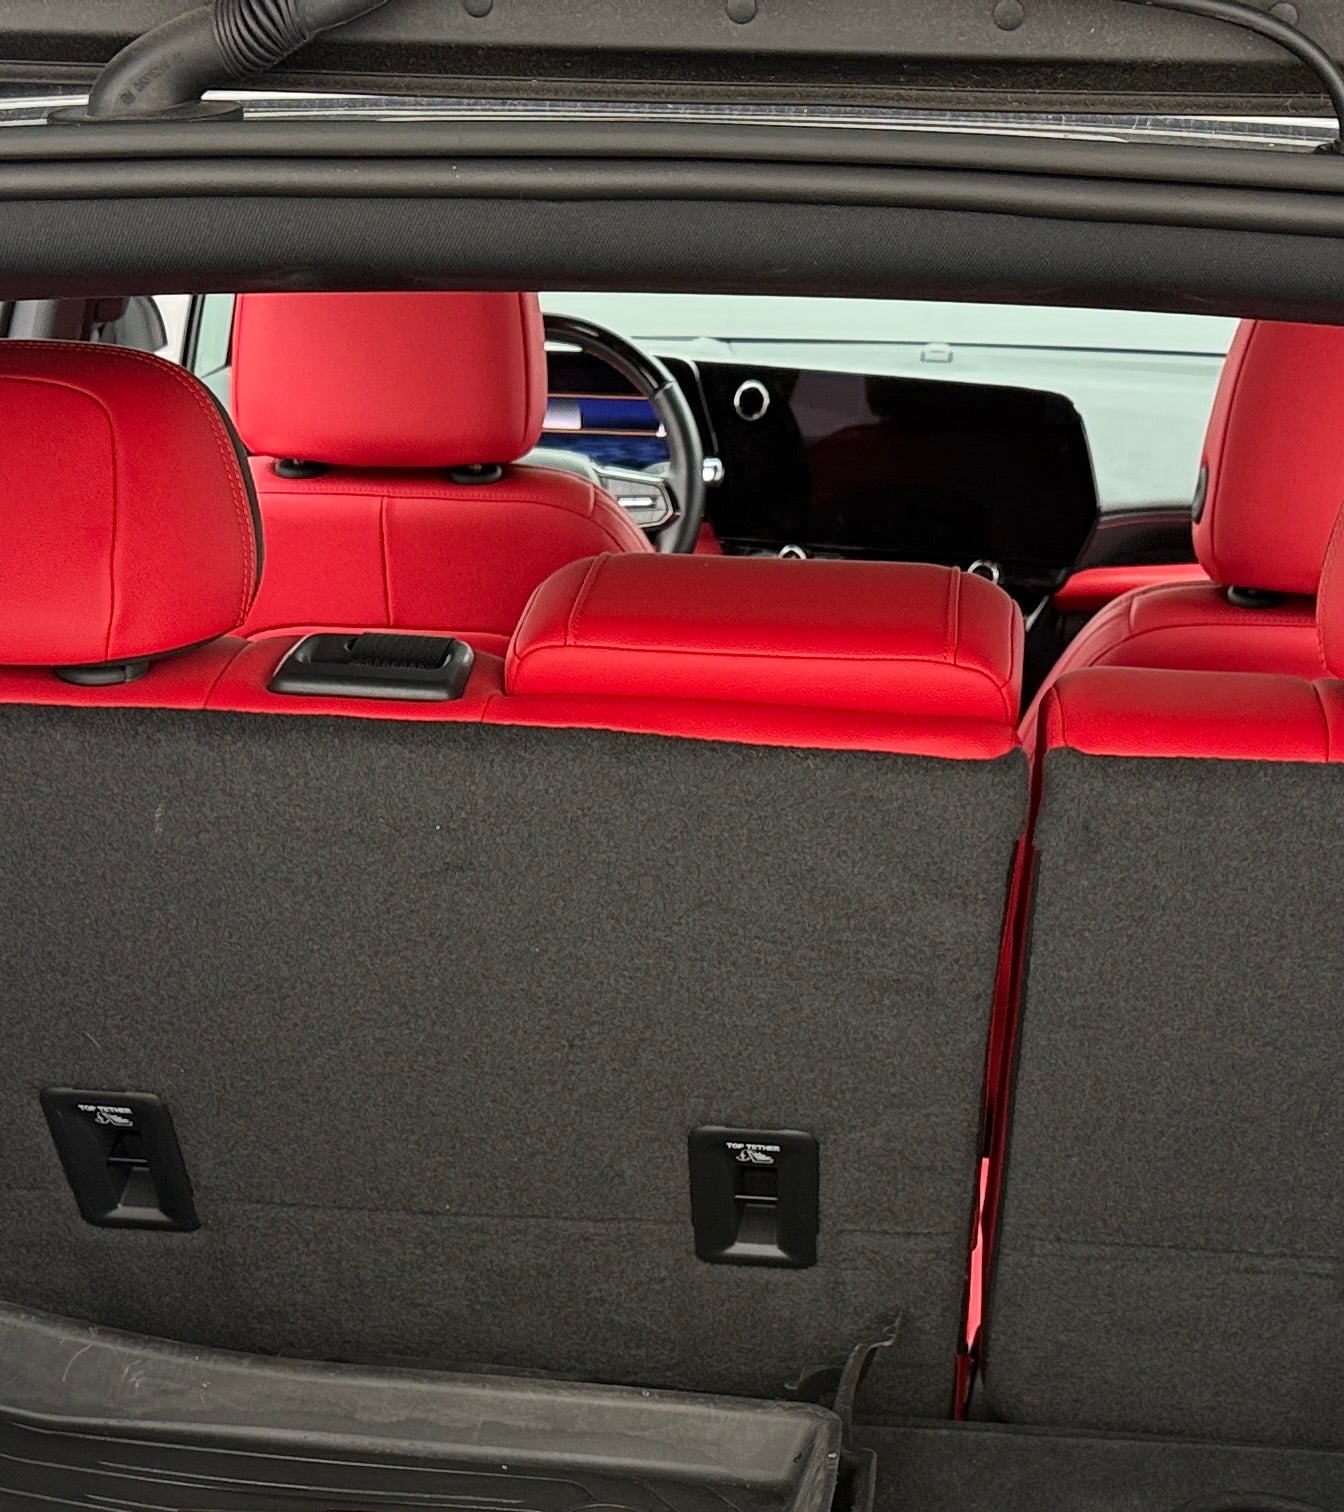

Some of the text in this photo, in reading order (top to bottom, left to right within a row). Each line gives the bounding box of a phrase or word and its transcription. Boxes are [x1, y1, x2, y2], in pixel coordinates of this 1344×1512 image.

[77, 1104, 97, 1112] TOP
[725, 1142, 781, 1152] TOP TETHER
